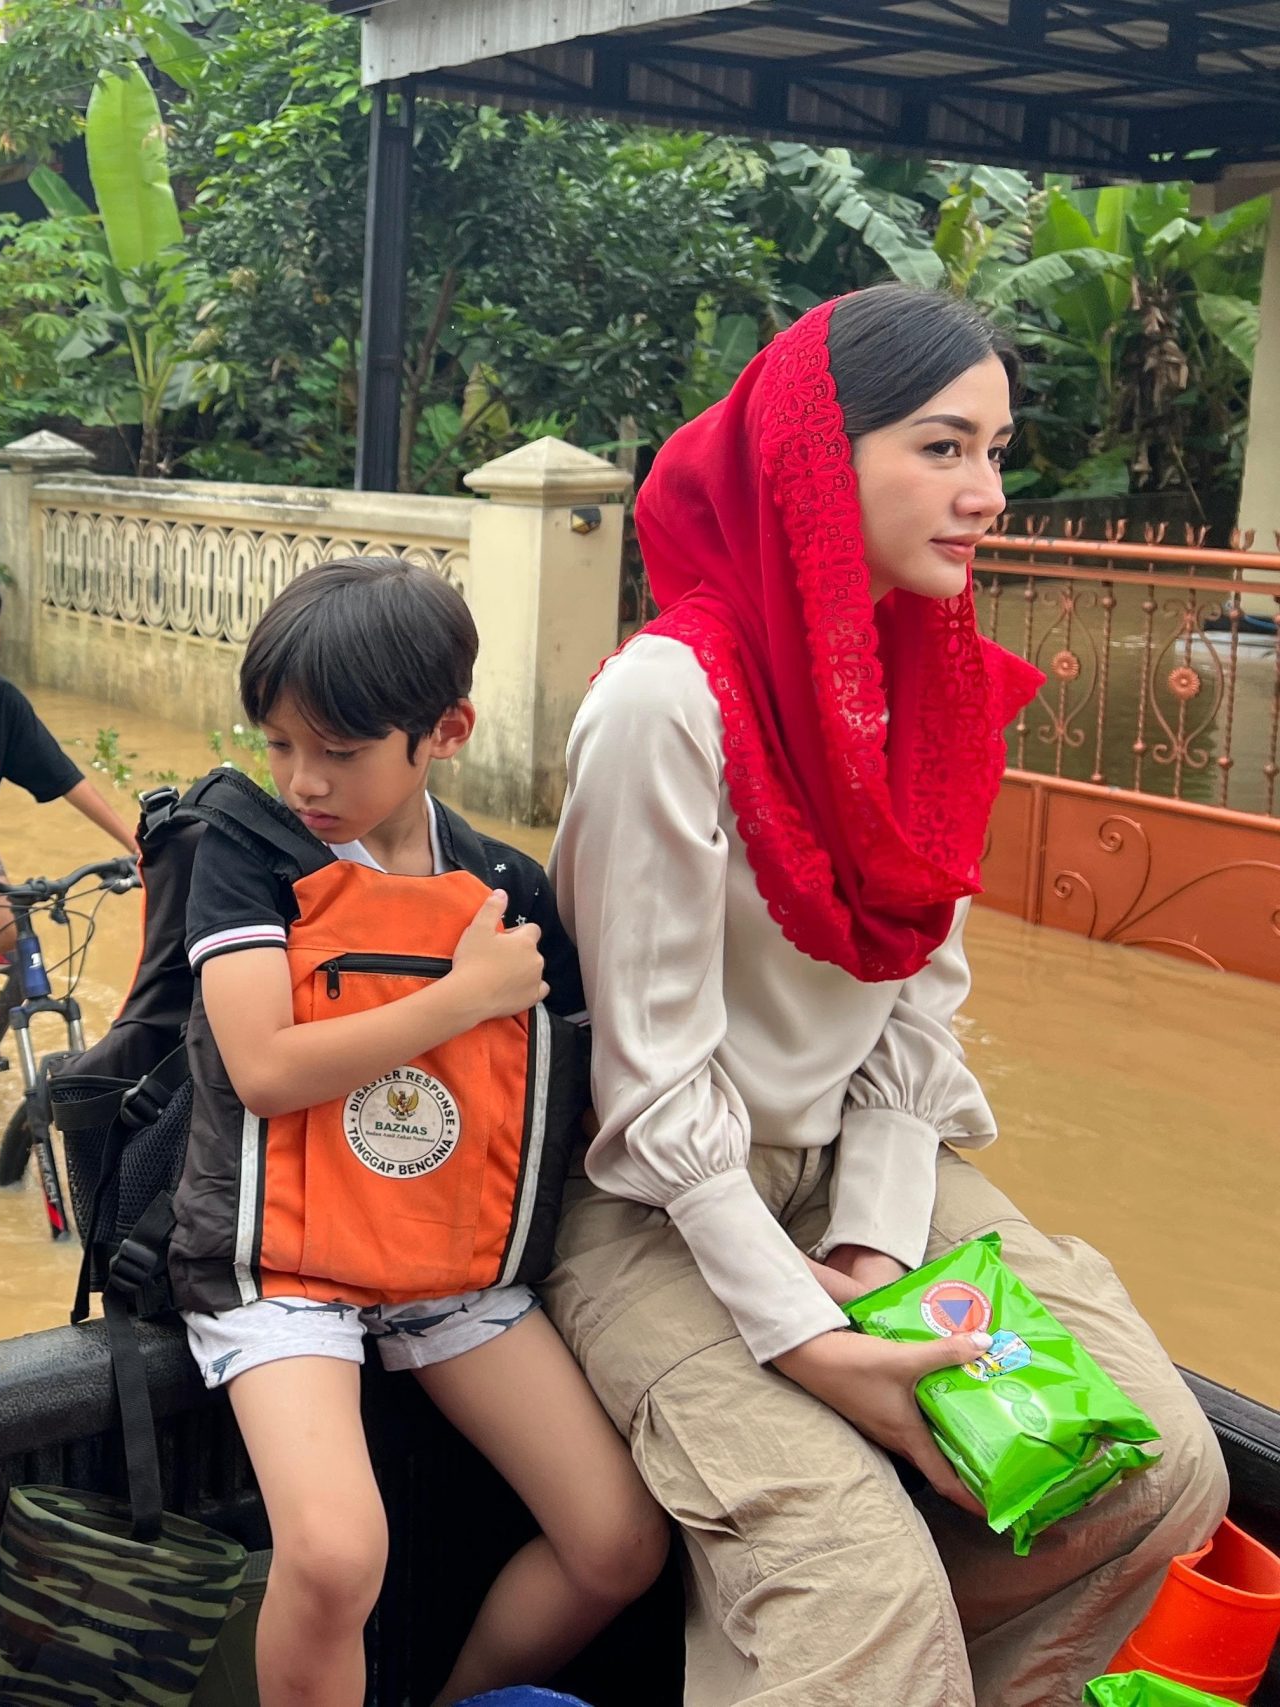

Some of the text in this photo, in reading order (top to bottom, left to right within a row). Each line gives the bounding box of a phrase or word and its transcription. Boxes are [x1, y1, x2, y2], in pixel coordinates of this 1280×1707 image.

[406, 1071, 455, 1126] RESPONSE
[348, 1126, 454, 1175] TANGGAP BENCANA
[375, 1121, 428, 1136] BAZNAS
